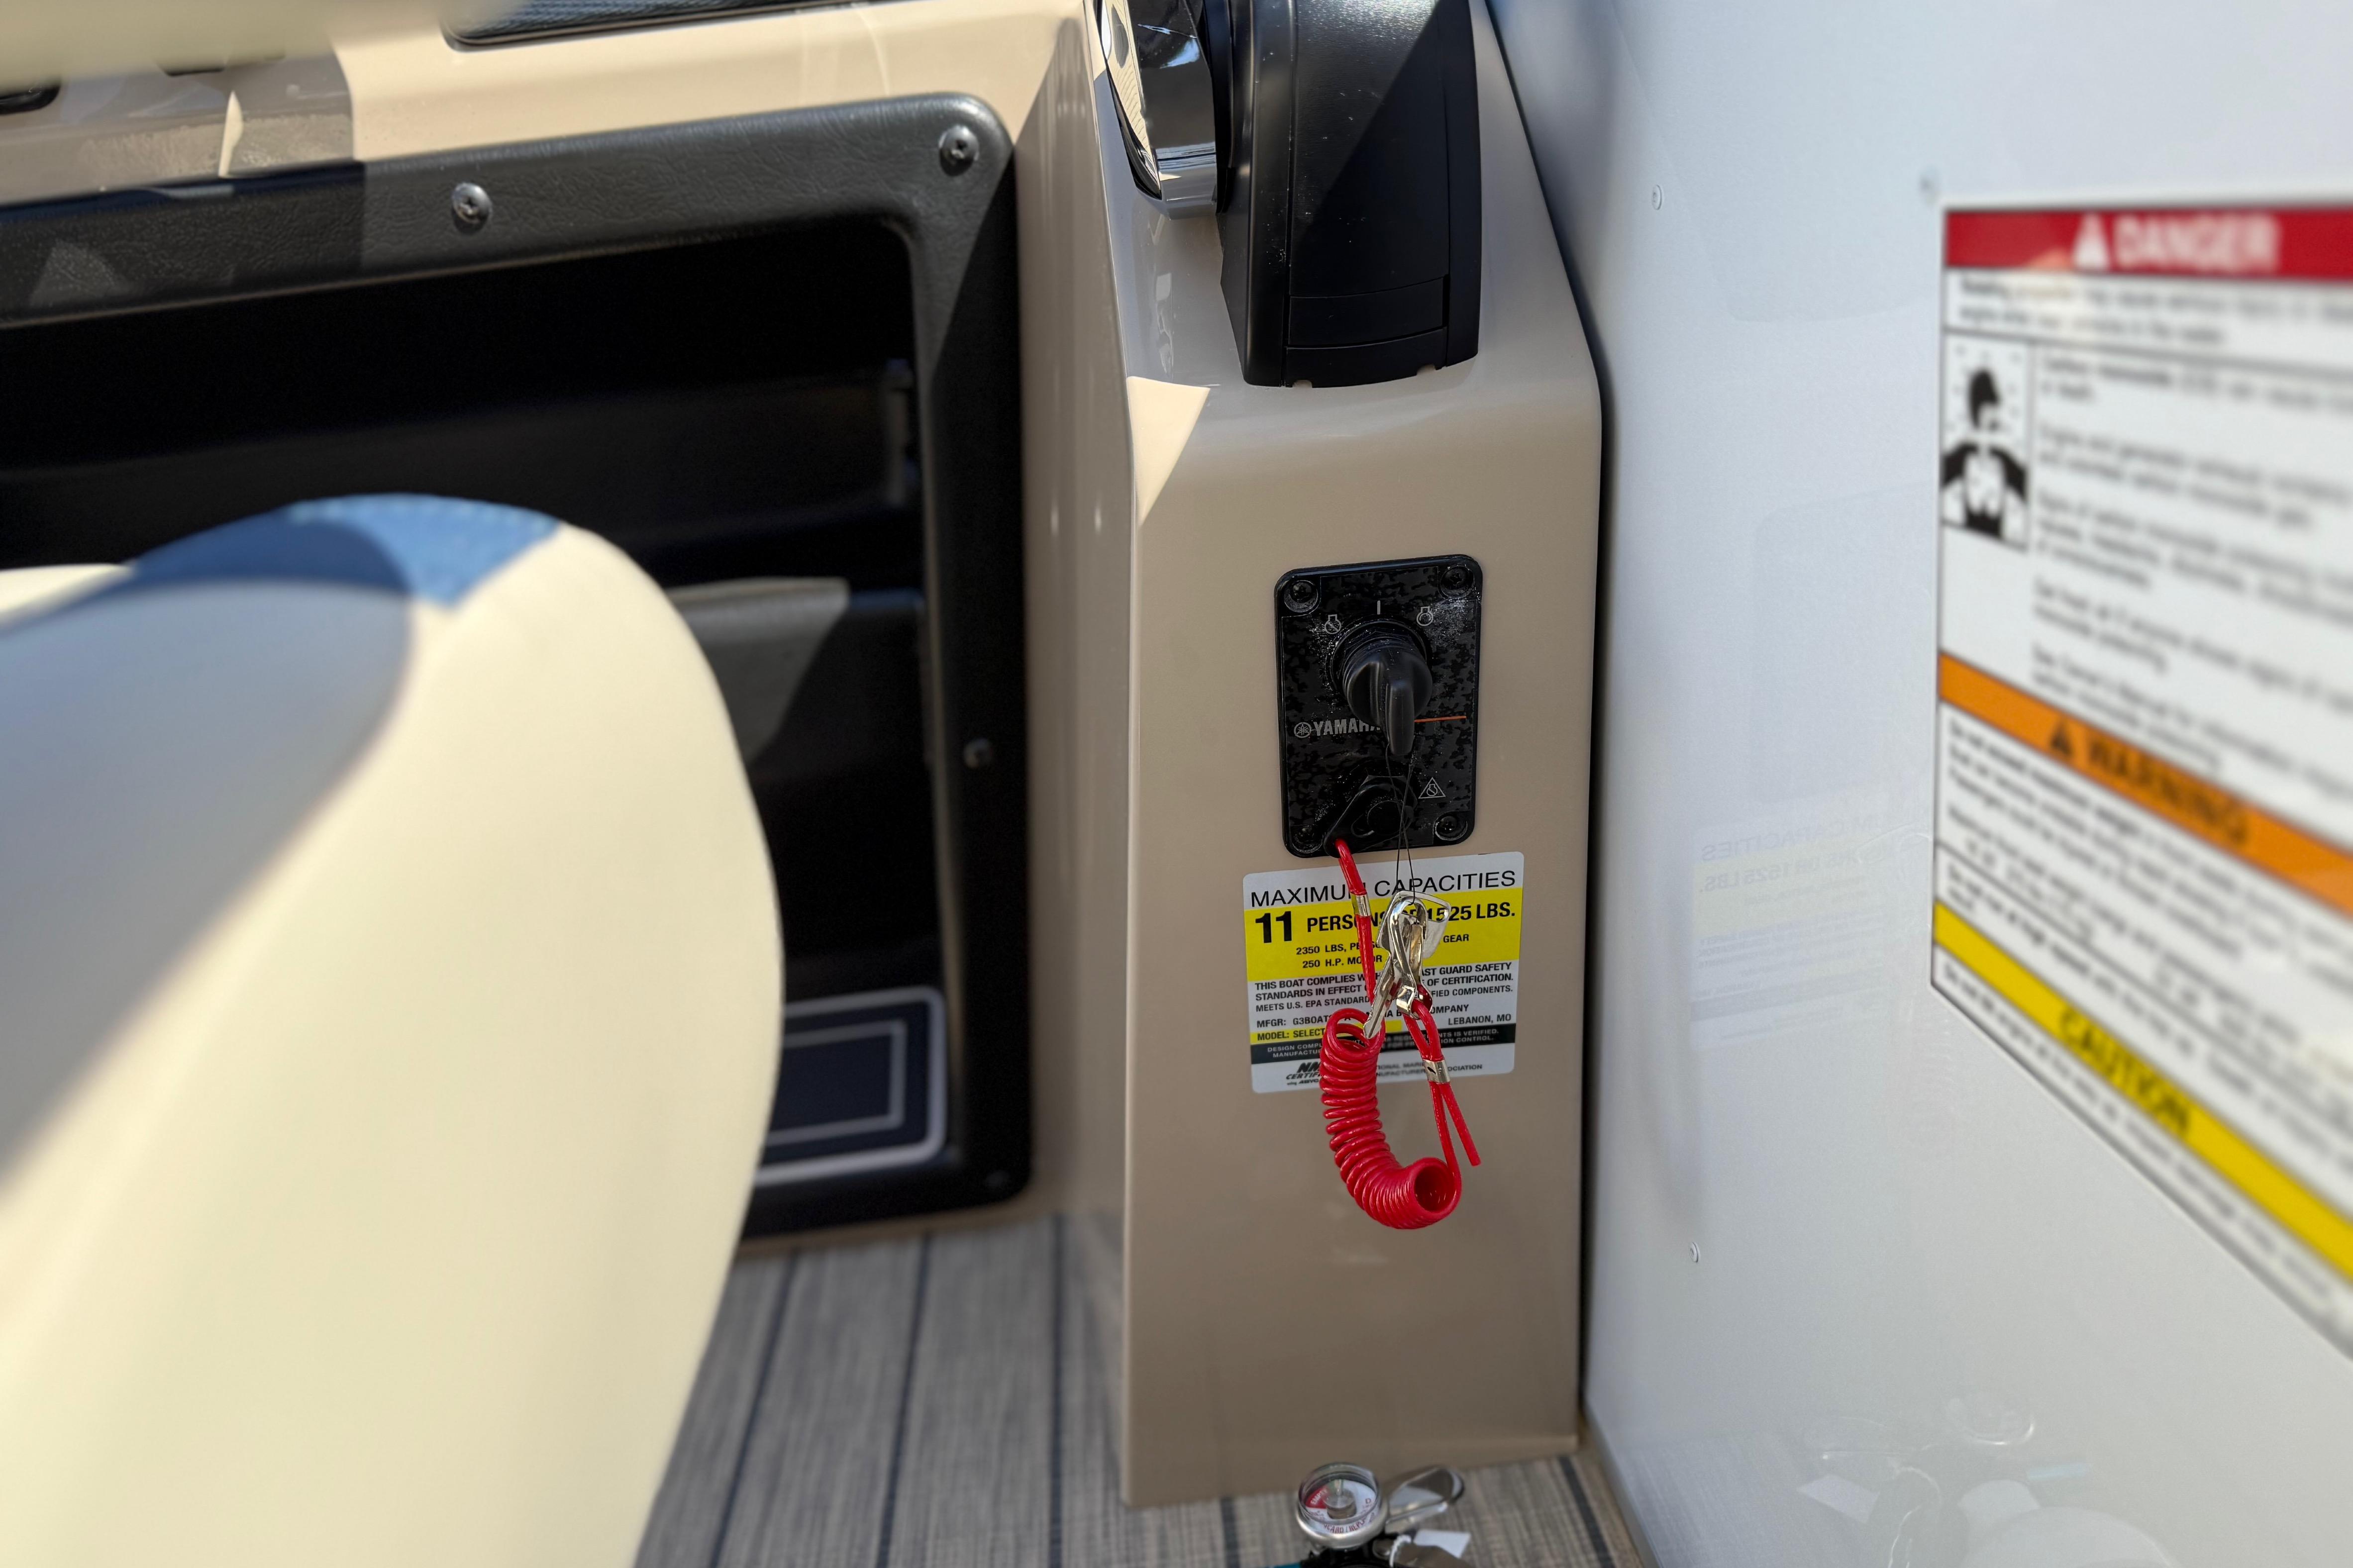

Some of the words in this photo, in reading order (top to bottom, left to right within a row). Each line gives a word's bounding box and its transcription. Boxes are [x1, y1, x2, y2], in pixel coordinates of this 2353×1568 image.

[1314, 718, 1381, 736] YAMAH
[1375, 871, 1515, 896] CAPACITIES
[1255, 911, 1292, 943] 11
[1476, 902, 1515, 919] LBS.
[1443, 934, 1469, 943] GEAR
[1296, 946, 1320, 955] 2350
[1325, 944, 1346, 953] LBS,
[1347, 955, 1382, 965] MOR
[1439, 965, 1472, 975] GUARD
[1475, 962, 1512, 972] SAFETY
[1255, 981, 1277, 990] THIS
[1279, 979, 1304, 988] BOAT
[1307, 975, 1355, 986] COMPLIES
[1427, 978, 1439, 986] OF
[1442, 973, 1514, 985] CERTIFICATION.
[1256, 989, 1313, 1001] STANDARDS
[1316, 986, 1325, 995] IN
[1328, 984, 1362, 994] EFFECT
[1452, 985, 1513, 996] COMPONENTS.
[1256, 1003, 1284, 1012] MEETS
[1287, 1001, 1303, 1009] U.S.
[1306, 999, 1322, 1007] EPA
[1325, 996, 1370, 1006] STANDARD
[1430, 1004, 1469, 1014] OMPANY
[1257, 1019, 1286, 1028] MFGR:
[1293, 1015, 1332, 1025] G3BOAT
[1448, 1015, 1493, 1025] LEBANON,
[1497, 1013, 1511, 1022] MO
[1257, 1032, 1289, 1041] MODEL:
